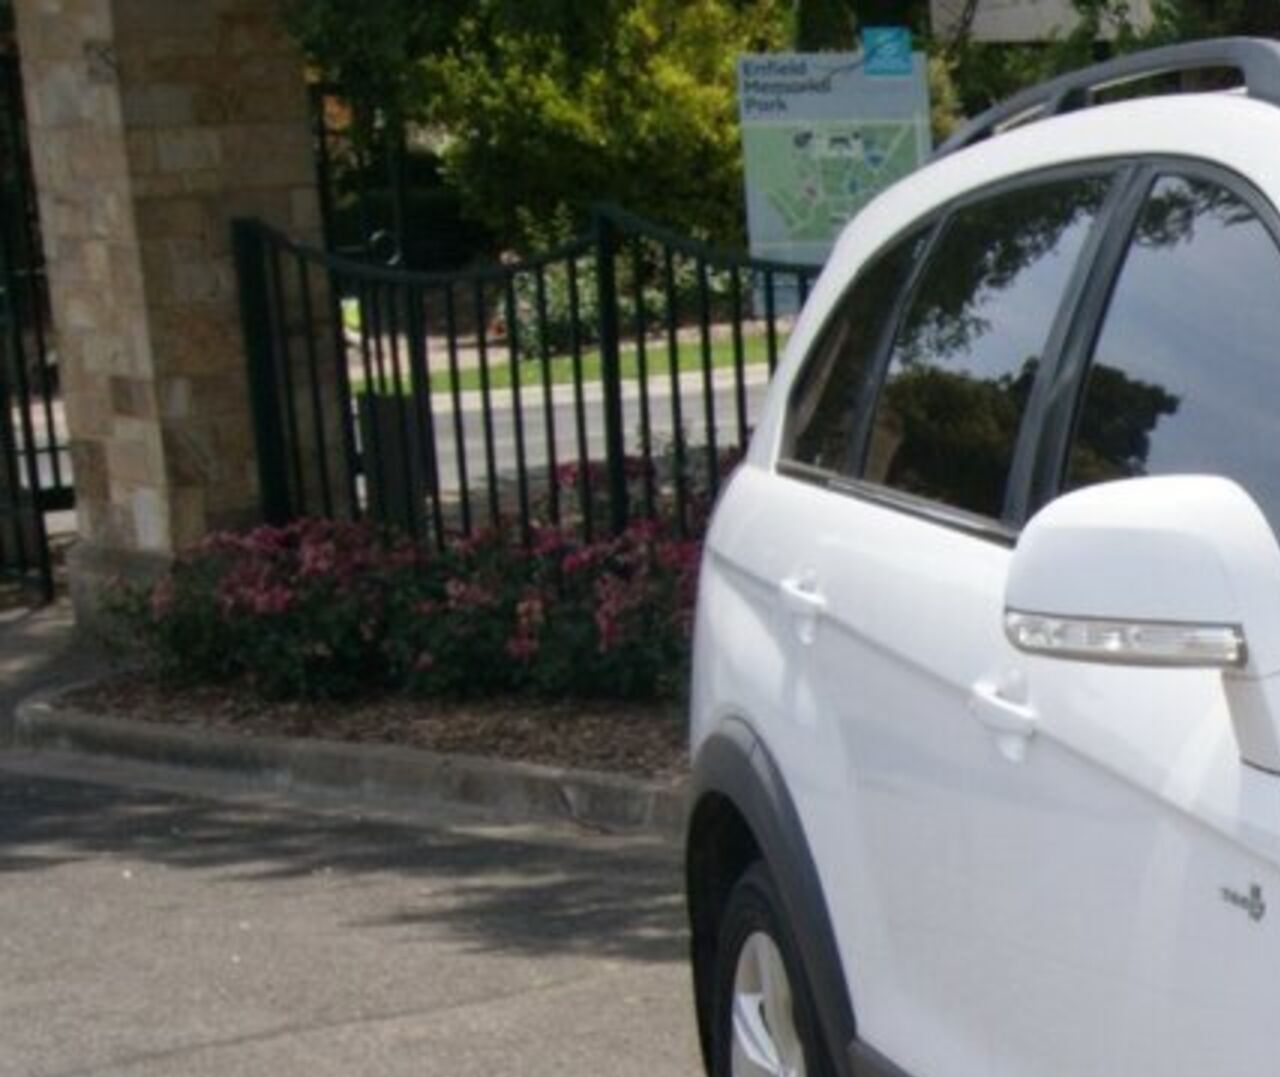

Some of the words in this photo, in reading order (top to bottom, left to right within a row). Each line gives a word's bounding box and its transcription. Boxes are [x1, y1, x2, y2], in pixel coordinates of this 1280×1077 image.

[743, 60, 808, 76] Enfield
[743, 77, 832, 94] Memorial
[743, 96, 788, 113] Park
